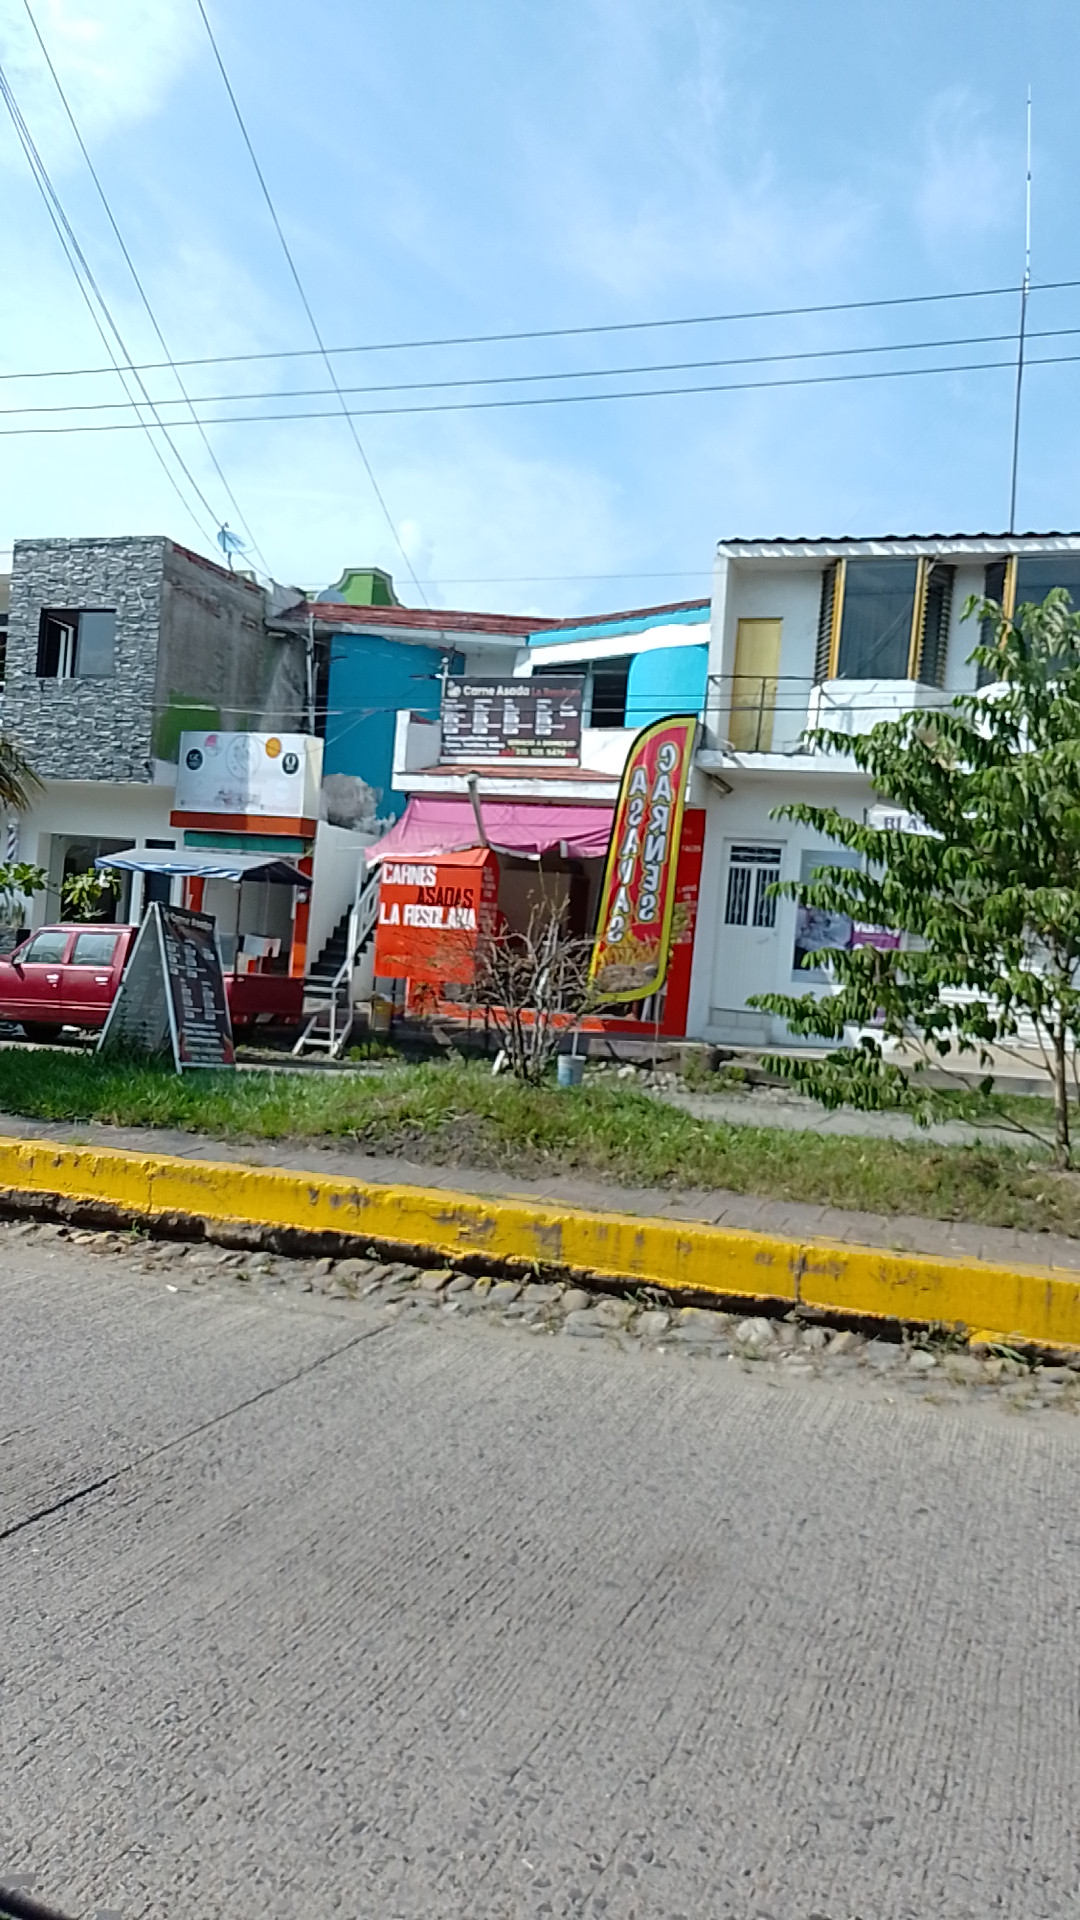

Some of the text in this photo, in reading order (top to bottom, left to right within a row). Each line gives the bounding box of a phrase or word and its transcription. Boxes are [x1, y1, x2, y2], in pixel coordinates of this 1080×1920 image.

[381, 863, 437, 886] CARNES
[417, 886, 474, 908] ASADAS
[379, 902, 400, 925] LA
